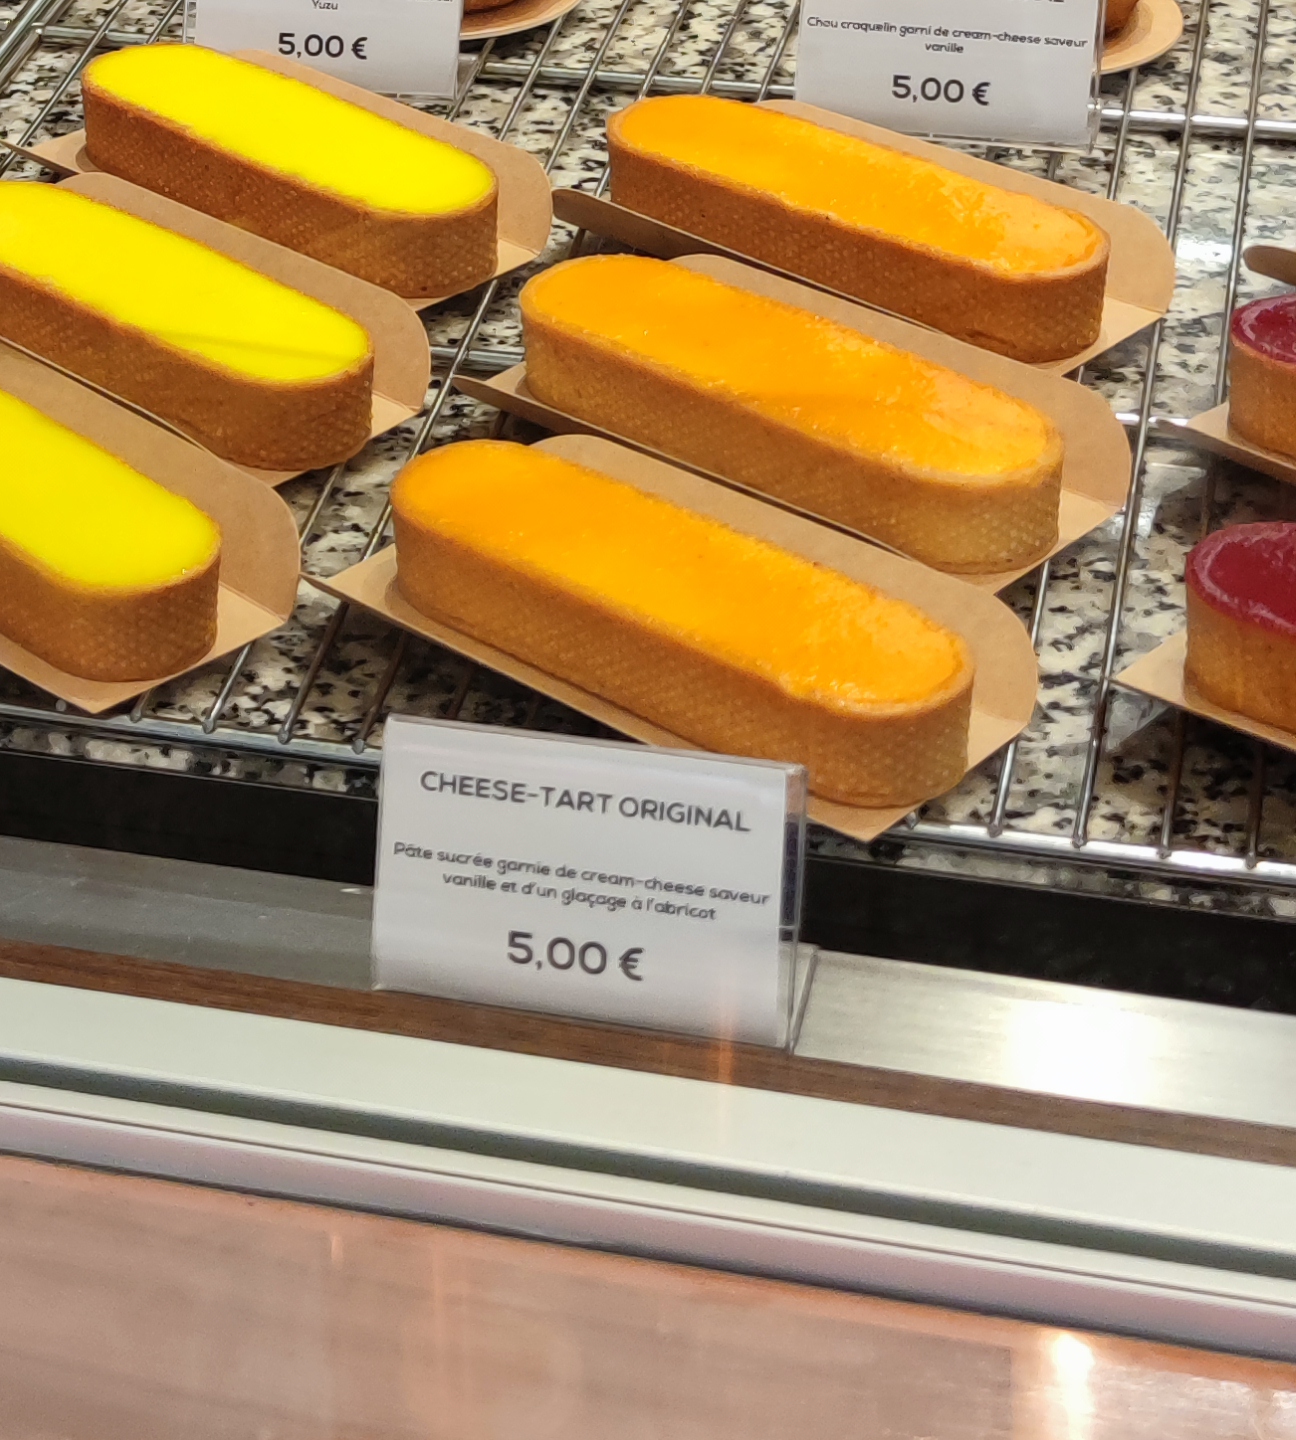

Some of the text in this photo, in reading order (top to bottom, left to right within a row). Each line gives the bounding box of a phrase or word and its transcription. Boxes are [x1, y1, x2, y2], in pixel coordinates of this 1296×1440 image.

[312, 0, 338, 10] Yuzu
[279, 33, 367, 59] 5,00 €
[807, 17, 1087, 47] Chou craquelin garni de cream-cheese saveur
[925, 43, 964, 53] vanille
[892, 75, 990, 106] 5,00 €
[421, 771, 750, 832] CHEESE-TART ORIGINAL
[394, 842, 770, 904] Pâte sucrée garnie de cream-cheese saveur
[443, 874, 716, 920] vanille et d'un glaçage à l'abricot
[508, 931, 644, 981] 5,00 €
